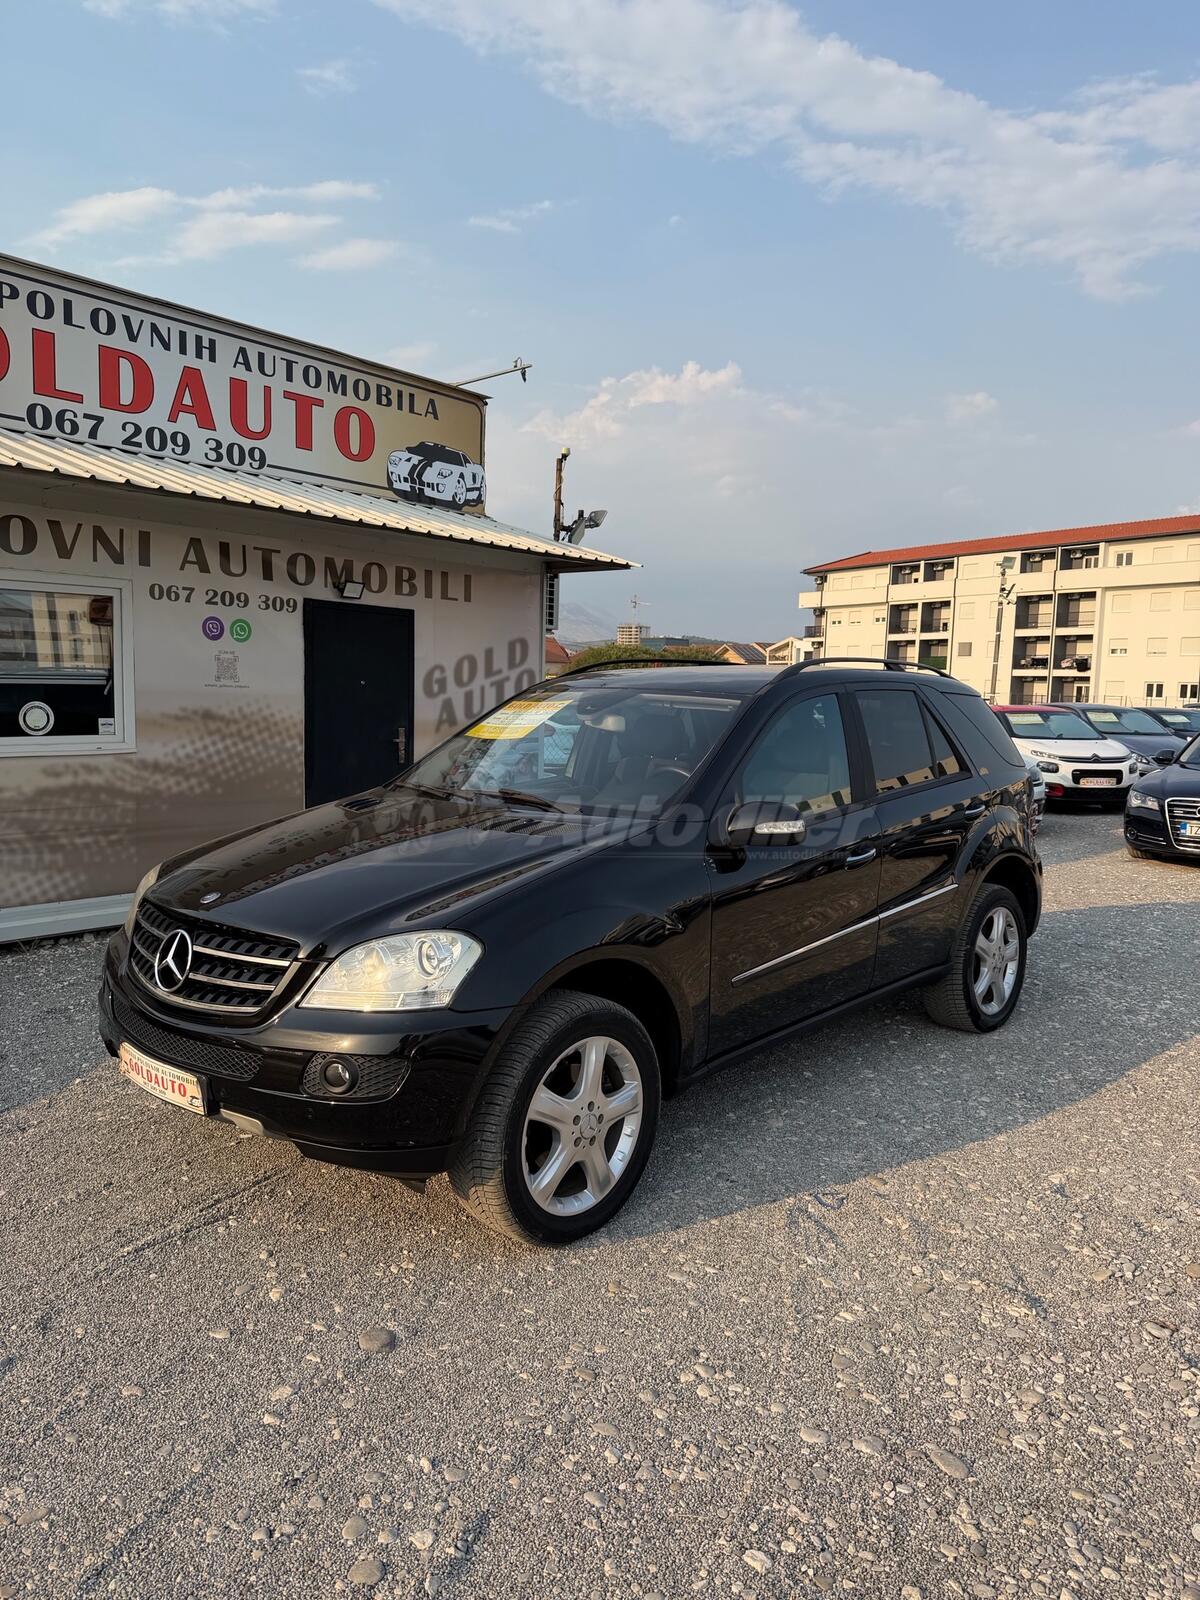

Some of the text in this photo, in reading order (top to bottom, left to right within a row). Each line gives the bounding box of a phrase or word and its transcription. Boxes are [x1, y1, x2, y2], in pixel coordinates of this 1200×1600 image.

[0, 281, 440, 421] POLOVNIH AUTOMOBILA
[0, 325, 376, 463] LDAUTO
[26, 402, 268, 471] 067 209 309
[148, 582, 299, 614] 067 209 309
[179, 536, 473, 603] AUTOMOBILI
[422, 636, 530, 700] GOLD
[434, 667, 537, 734] AUTO
[129, 1058, 187, 1098] GOLDAUTO
